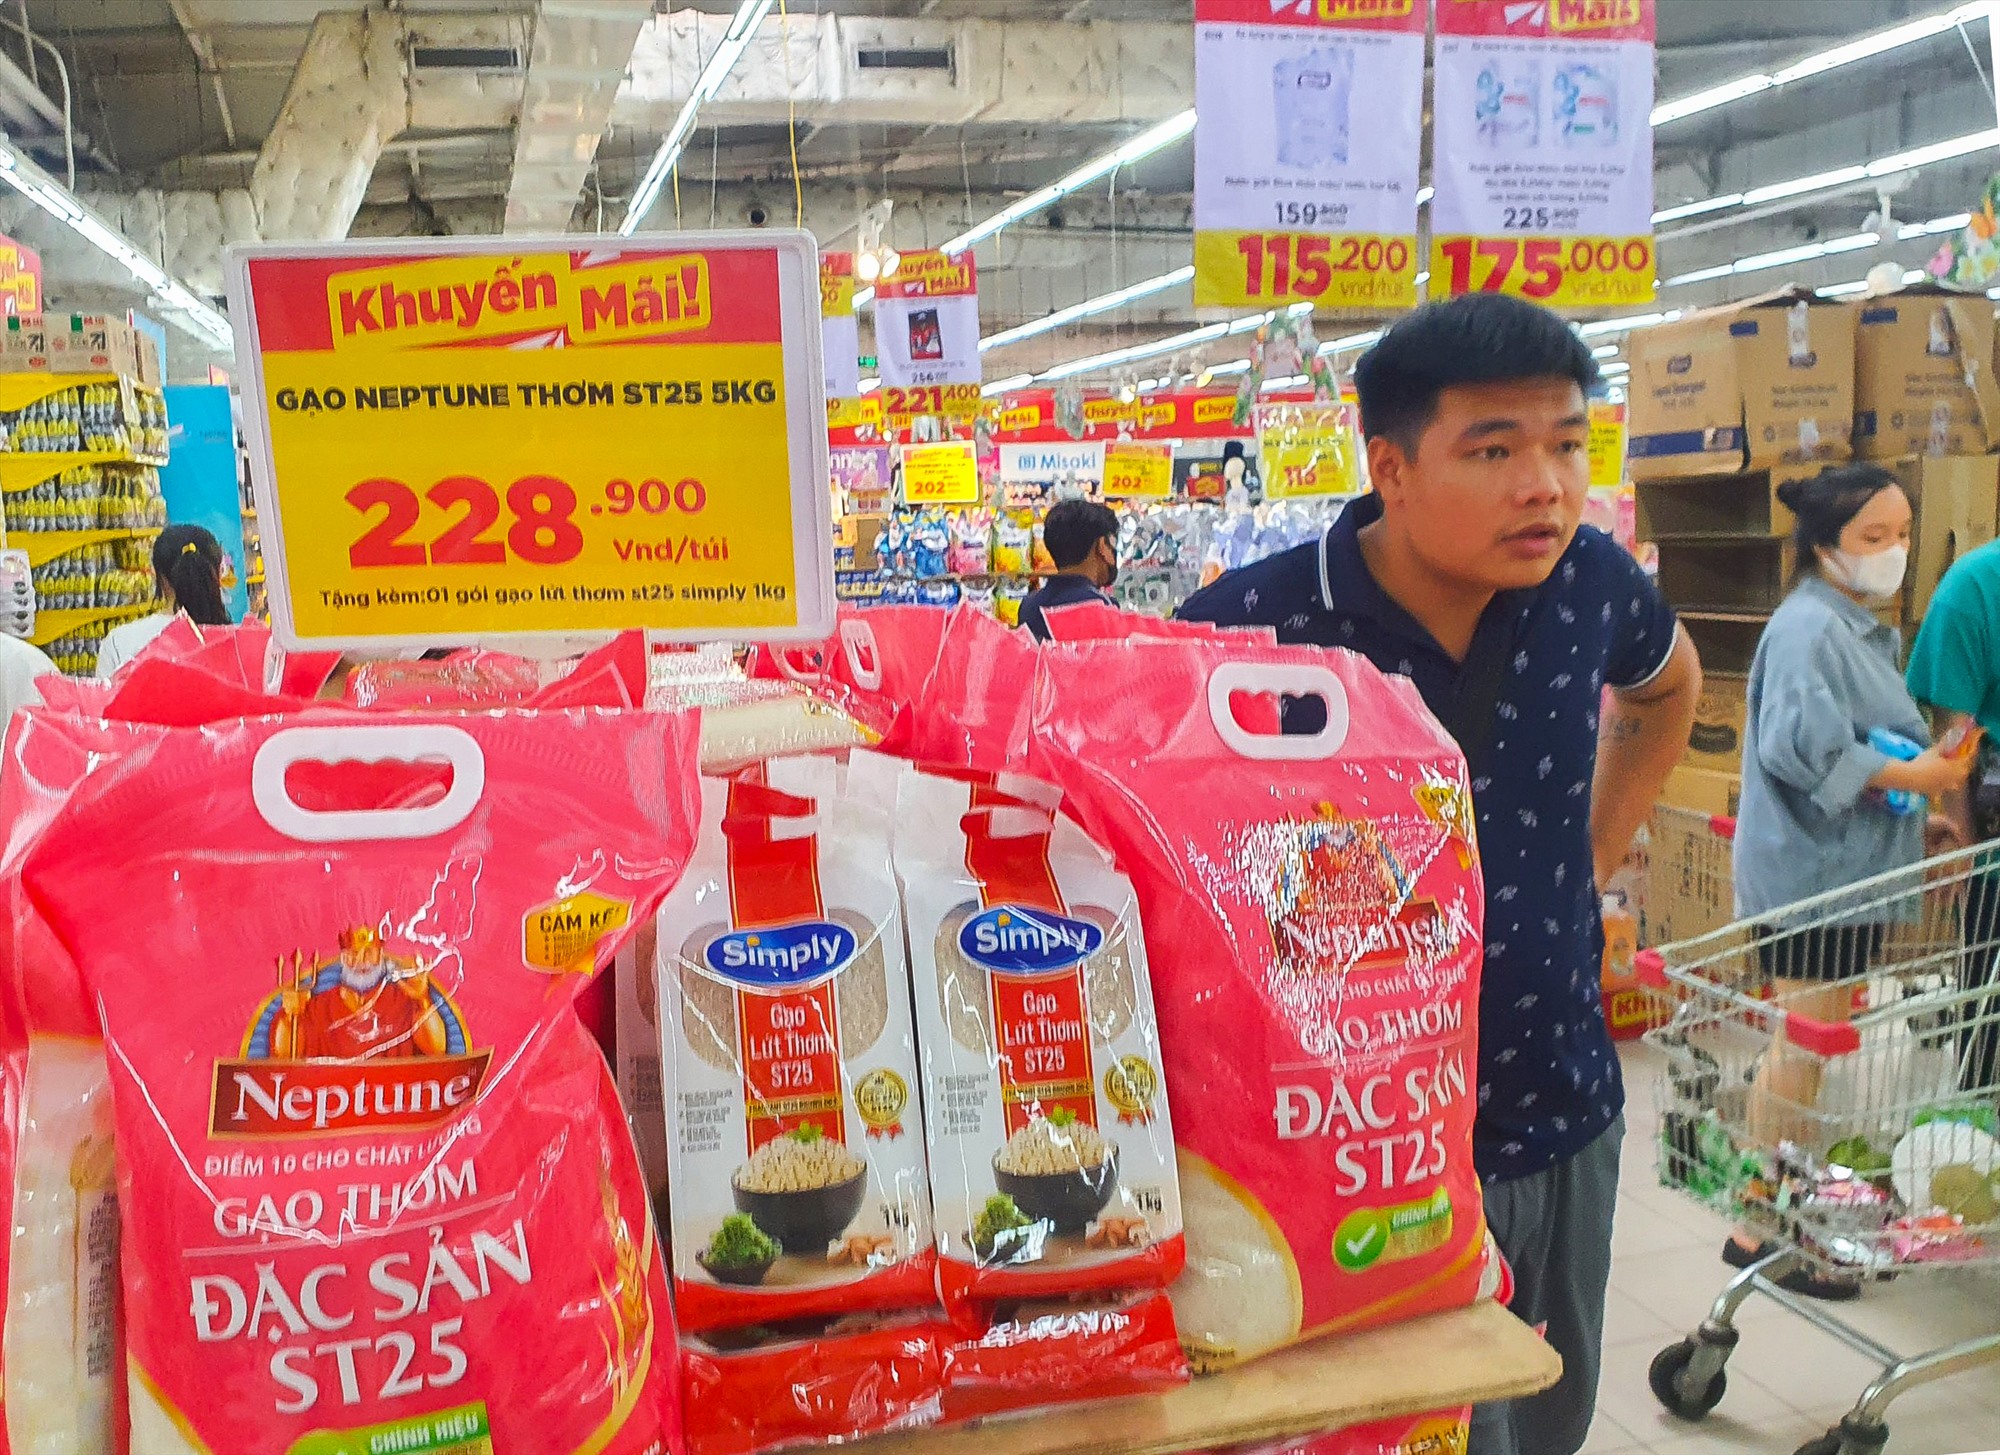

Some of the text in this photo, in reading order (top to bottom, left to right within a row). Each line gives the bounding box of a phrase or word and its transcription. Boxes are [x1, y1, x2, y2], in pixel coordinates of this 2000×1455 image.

[1238, 234, 1332, 298] 115
[1441, 239, 1562, 298] 175
[338, 257, 701, 337] Khuyến Mãi!
[275, 379, 776, 418] GẠO NEPTUNE THƠM ST25 5KG
[886, 386, 943, 415] 221
[1040, 451, 1096, 470] Misaki
[914, 481, 945, 495] 202
[1111, 474, 1143, 491] 202
[343, 474, 584, 570] 228
[612, 535, 730, 565] Vnd/túi
[320, 588, 370, 610] Tặng
[495, 588, 533, 606] gạo
[573, 583, 625, 602] thơm
[681, 582, 746, 602] simply
[754, 582, 786, 602] 1kg
[723, 933, 843, 972] Simply
[975, 913, 1088, 957] Simply
[1023, 989, 1057, 1018] Gạo
[770, 1059, 815, 1089] ST25
[1024, 1044, 1066, 1074] ST25
[230, 1069, 472, 1130] Neptune
[1273, 1073, 1397, 1140] ĐẶC
[271, 1155, 297, 1175] 10
[302, 1148, 350, 1173] CHO
[1335, 1119, 1447, 1197] ST25
[213, 1187, 324, 1245] GẠO
[189, 1261, 355, 1343] ĐẶC
[368, 1219, 533, 1322] SẢN
[269, 1316, 469, 1415] ST25
